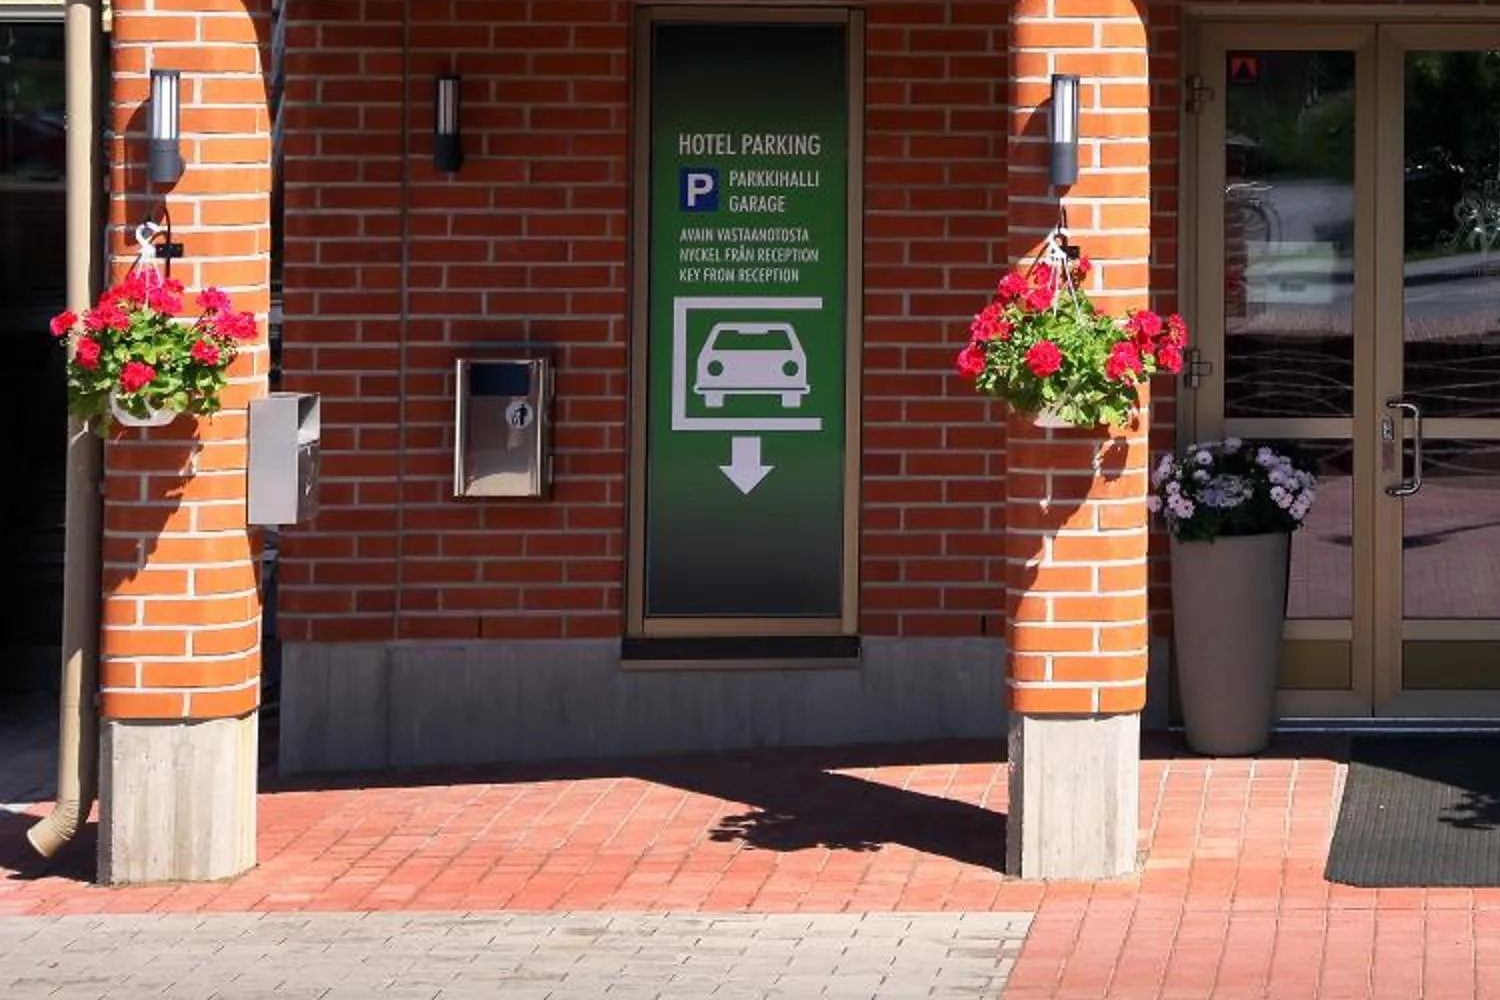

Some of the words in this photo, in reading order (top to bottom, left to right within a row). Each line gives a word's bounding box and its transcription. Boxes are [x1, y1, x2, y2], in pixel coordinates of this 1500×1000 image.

[679, 133, 737, 155] HOTEL
[741, 134, 821, 155] PARKING
[729, 171, 820, 187] PARKKIHALLI
[687, 173, 713, 206] P
[729, 196, 785, 213] GARAGE
[679, 228, 713, 242] AVAIN
[717, 228, 809, 242] VASTAANOTOSTA
[679, 248, 720, 262] NYCKEL
[725, 245, 755, 262] FRÅN
[757, 248, 819, 262] RECEPTION
[679, 268, 701, 282] KEY
[703, 268, 735, 282] FROM
[737, 268, 799, 282] RECEPTION
